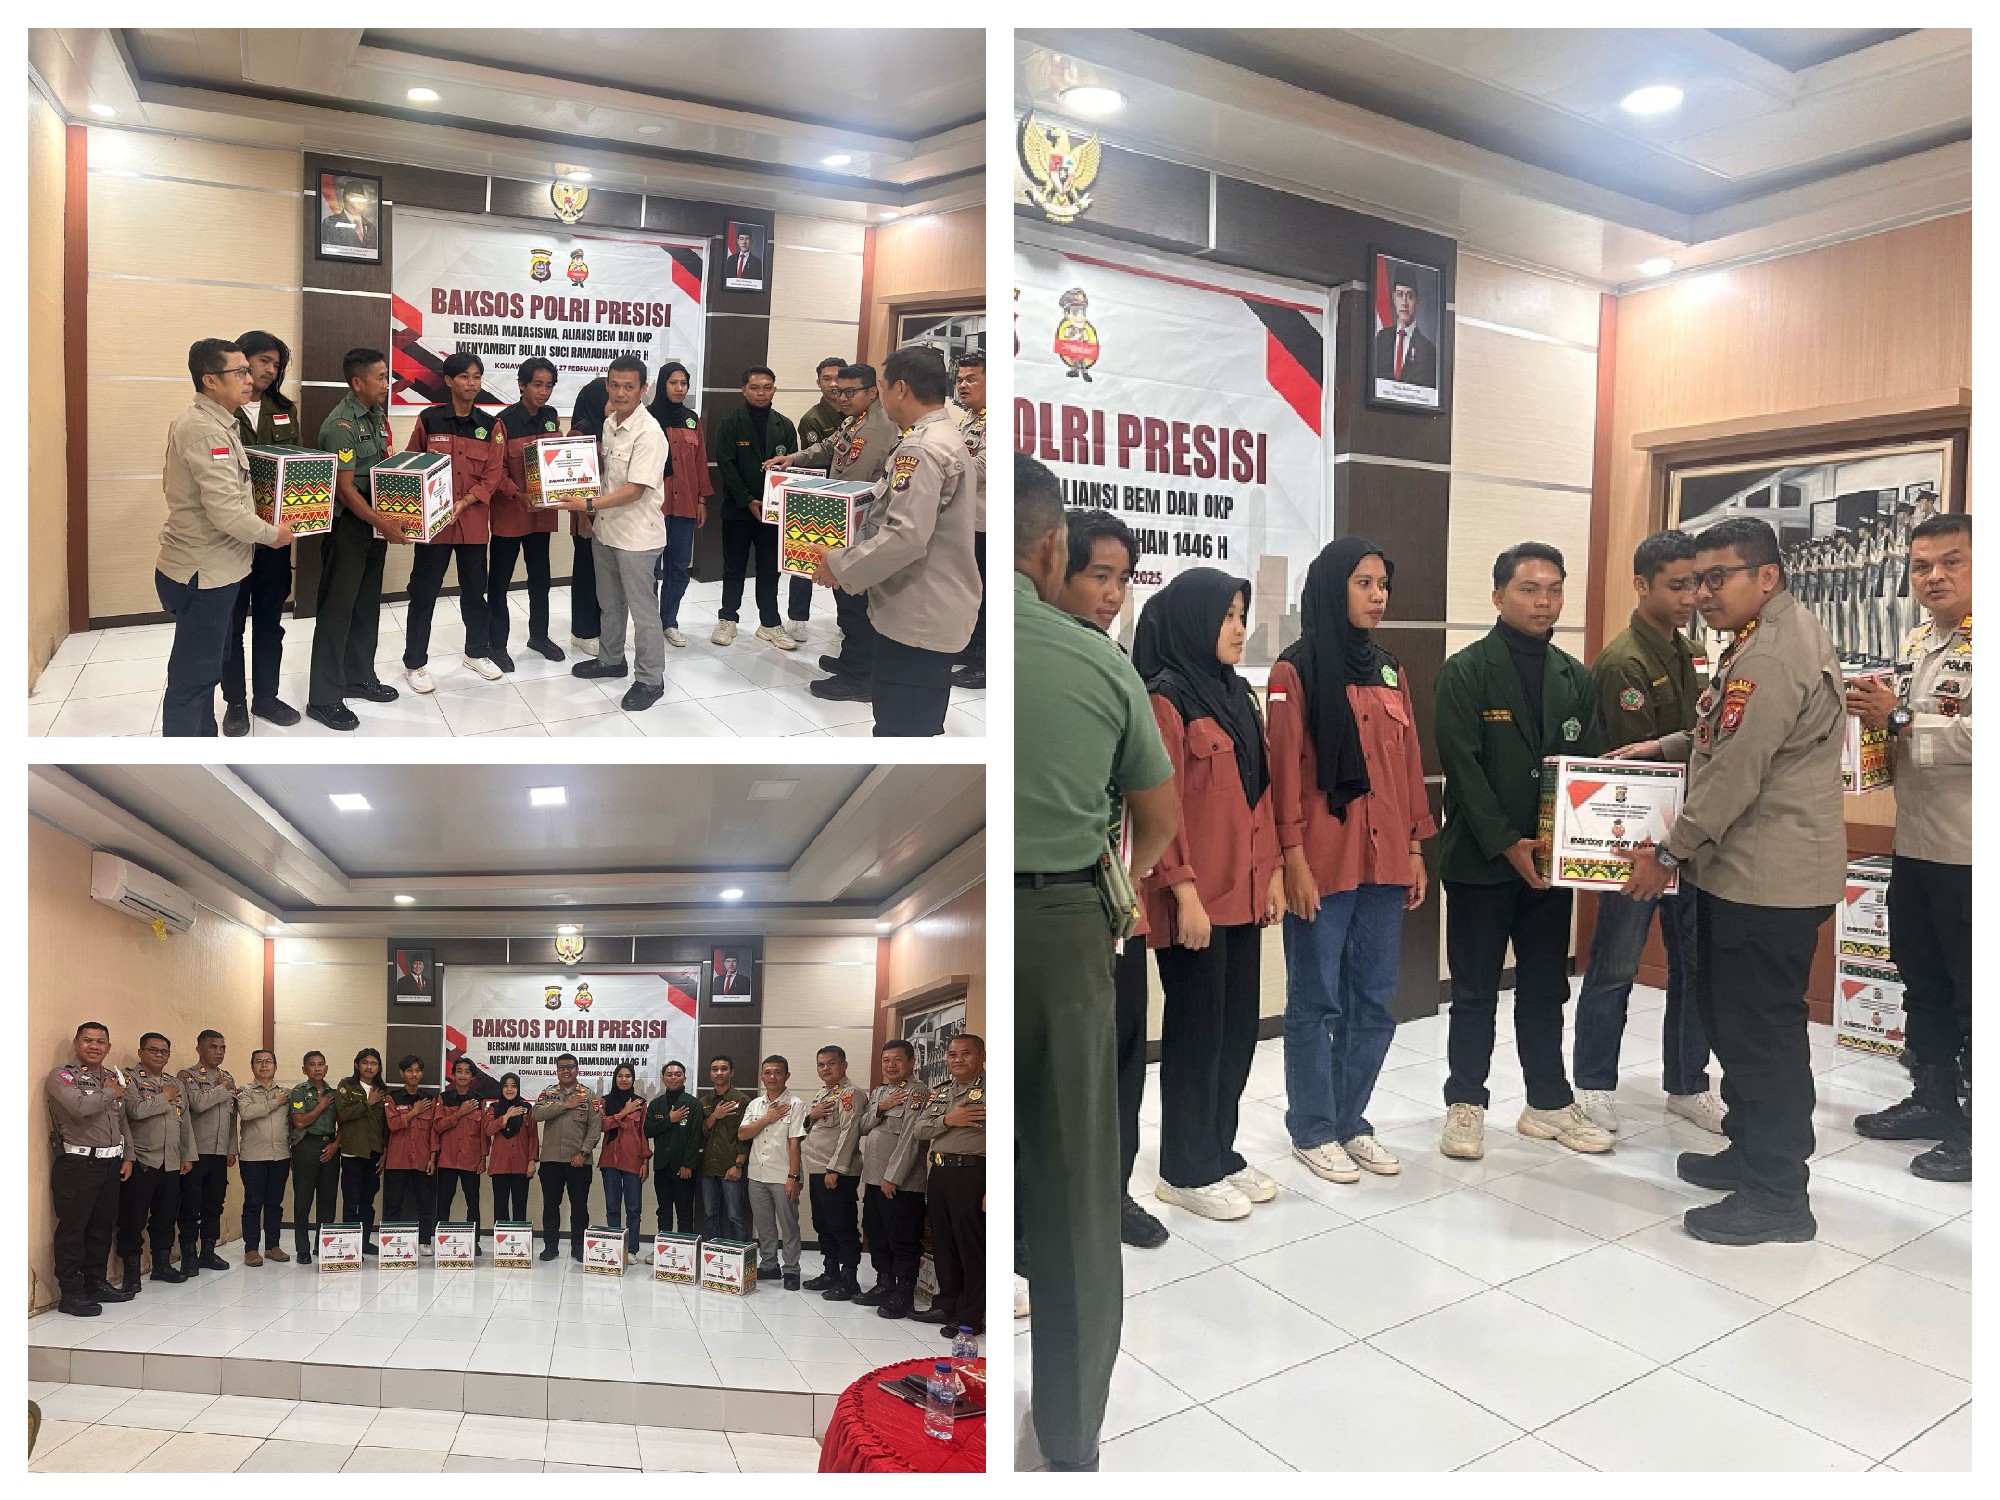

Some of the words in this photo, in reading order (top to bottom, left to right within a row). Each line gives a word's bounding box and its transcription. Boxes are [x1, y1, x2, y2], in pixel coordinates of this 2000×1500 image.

[431, 288, 524, 319] BAKSOS
[530, 295, 589, 322] POLRI
[595, 299, 671, 328] PRESISI
[453, 322, 499, 336] BERSAMA
[502, 325, 559, 340] MAHASISWA,
[562, 328, 595, 342] ALIANSI
[597, 329, 616, 342] BEM
[618, 330, 634, 343] DAN
[637, 332, 652, 343] OKP
[455, 341, 516, 355] MENYAMBUT
[519, 344, 547, 357] BULAN
[549, 346, 569, 358] SUCI
[571, 347, 619, 359] RAMADHAN
[643, 350, 649, 361] H
[1014, 397, 1105, 466] OLRI
[1118, 413, 1267, 485] PRESISI
[1062, 478, 1118, 510] LIANSI
[1123, 486, 1160, 514] BEM
[1167, 490, 1198, 516] DAN
[1205, 493, 1234, 519] OKP
[1173, 531, 1212, 559] 1446
[1218, 536, 1228, 561] H
[1132, 570, 1163, 585] 2025
[472, 1018, 540, 1039] BAKSOS
[545, 1019, 594, 1039] POLRI
[598, 1019, 667, 1039] PRESISI
[487, 1041, 520, 1051] BERSAMA
[523, 1042, 569, 1052] MAHASISWA,
[571, 1042, 598, 1052] ALIANSI
[600, 1043, 616, 1052] BEM
[619, 1043, 633, 1052] DAN
[635, 1043, 650, 1053] OKP
[489, 1055, 533, 1065] MENYAMBUT
[578, 1056, 620, 1066] RAMADHAN
[641, 1058, 647, 1066] H
